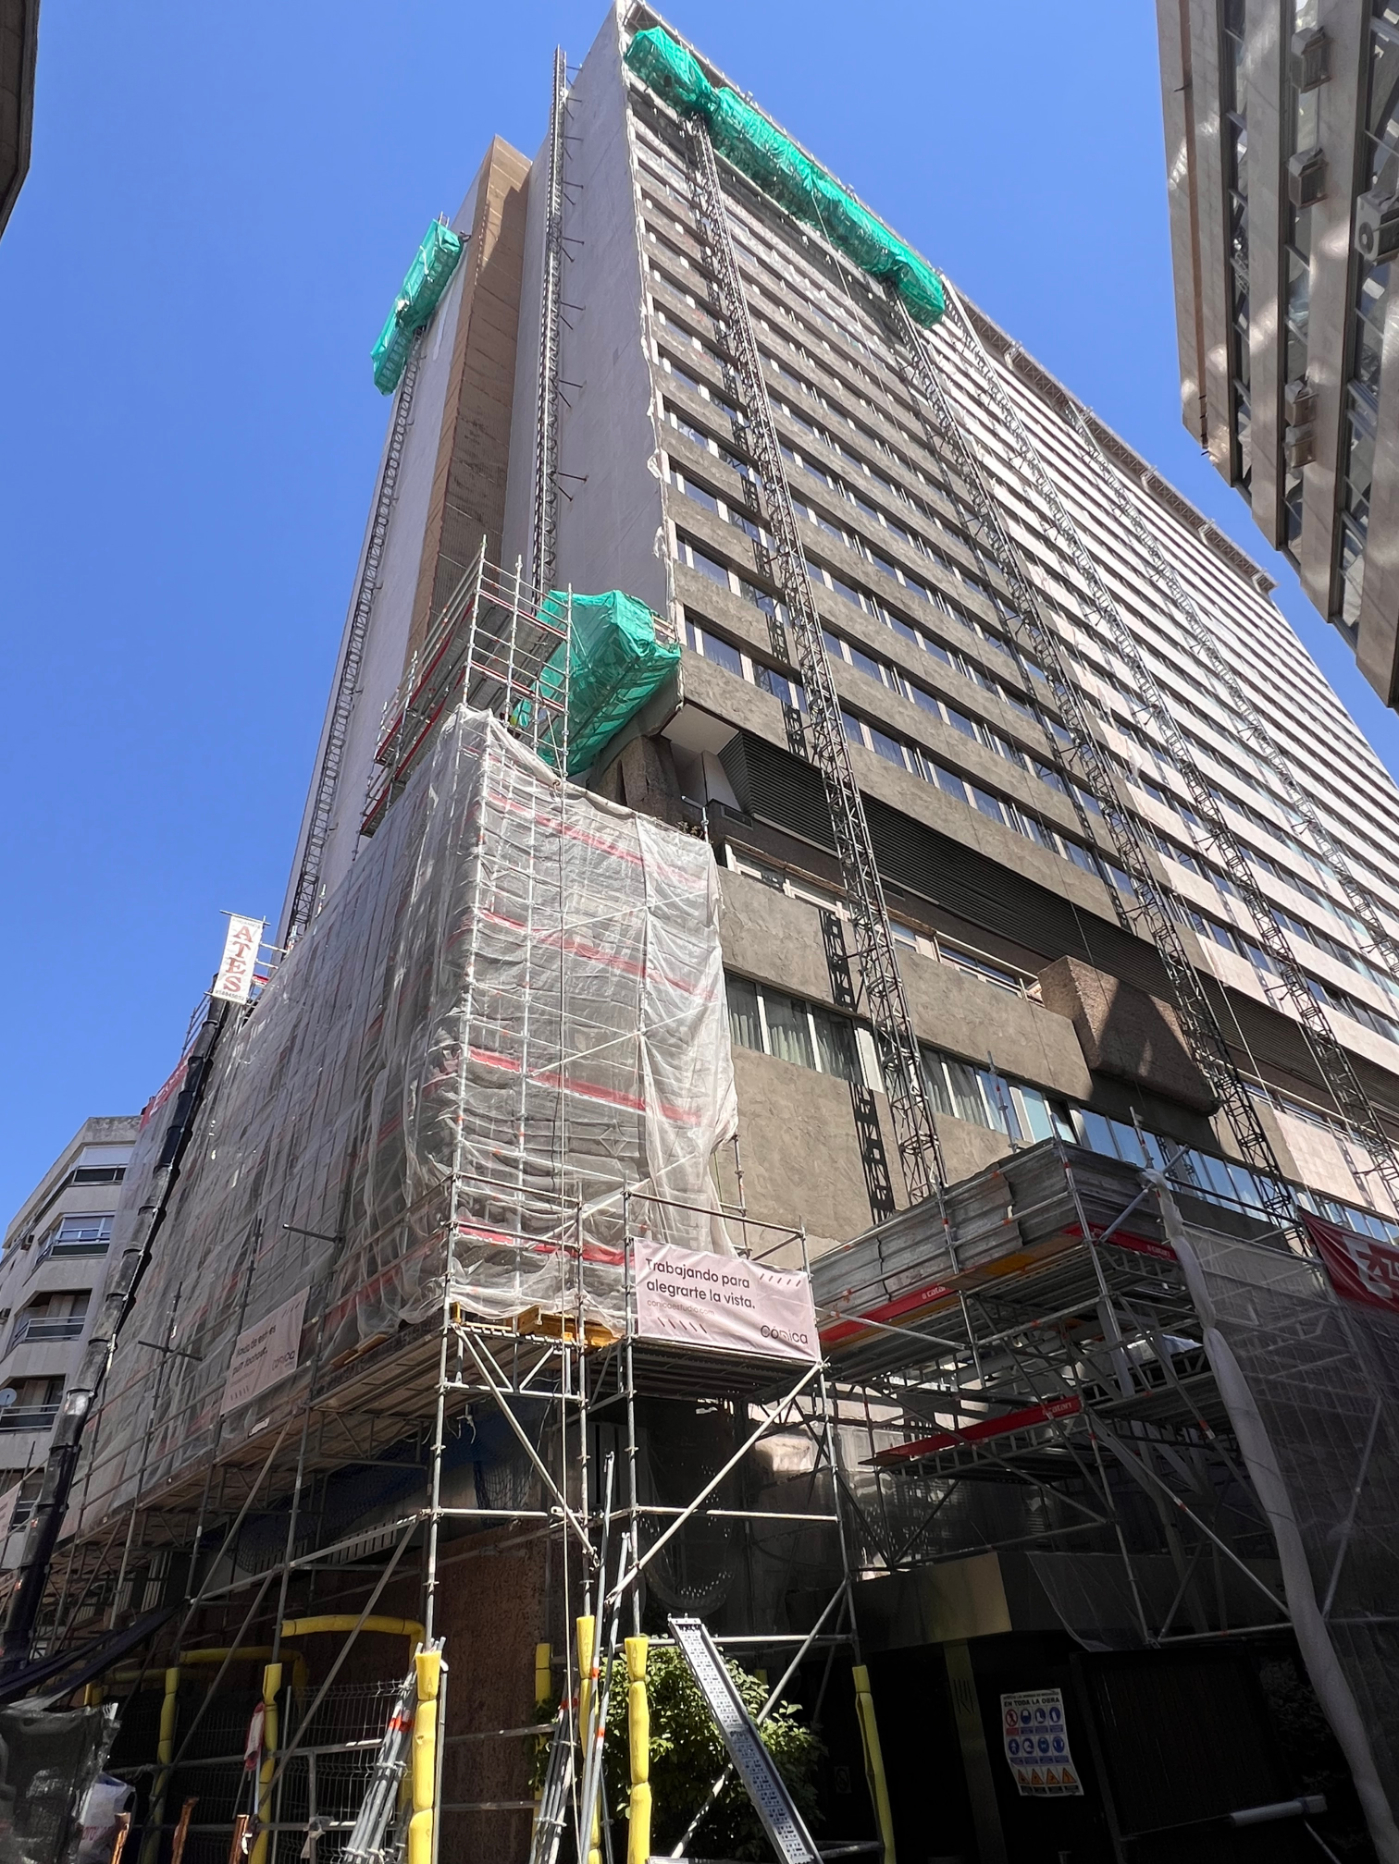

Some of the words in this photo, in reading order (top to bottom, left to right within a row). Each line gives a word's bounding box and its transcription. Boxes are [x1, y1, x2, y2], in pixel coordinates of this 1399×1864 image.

[223, 925, 254, 993] ATES
[645, 1258, 719, 1282] Trabajando
[721, 1274, 750, 1289] para
[646, 1279, 707, 1300] alegrarte
[709, 1289, 721, 1303] la
[723, 1292, 755, 1309] vista.
